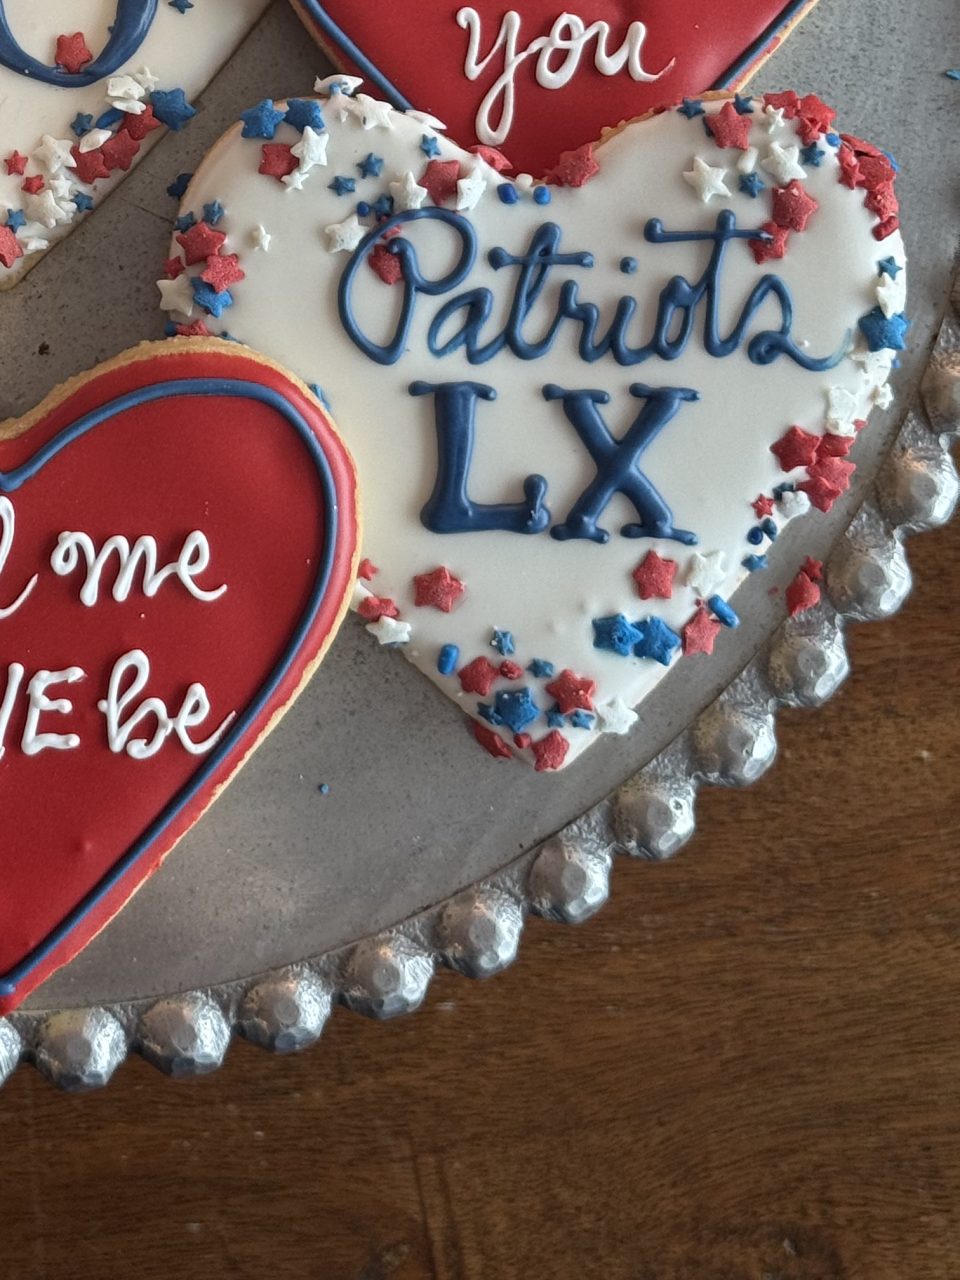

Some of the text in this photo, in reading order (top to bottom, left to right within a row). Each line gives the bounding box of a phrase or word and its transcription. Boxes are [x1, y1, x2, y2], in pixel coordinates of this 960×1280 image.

[456, 6, 675, 145] you
[338, 206, 854, 372] Patriots
[409, 381, 699, 545] LX
[50, 530, 226, 606] me
